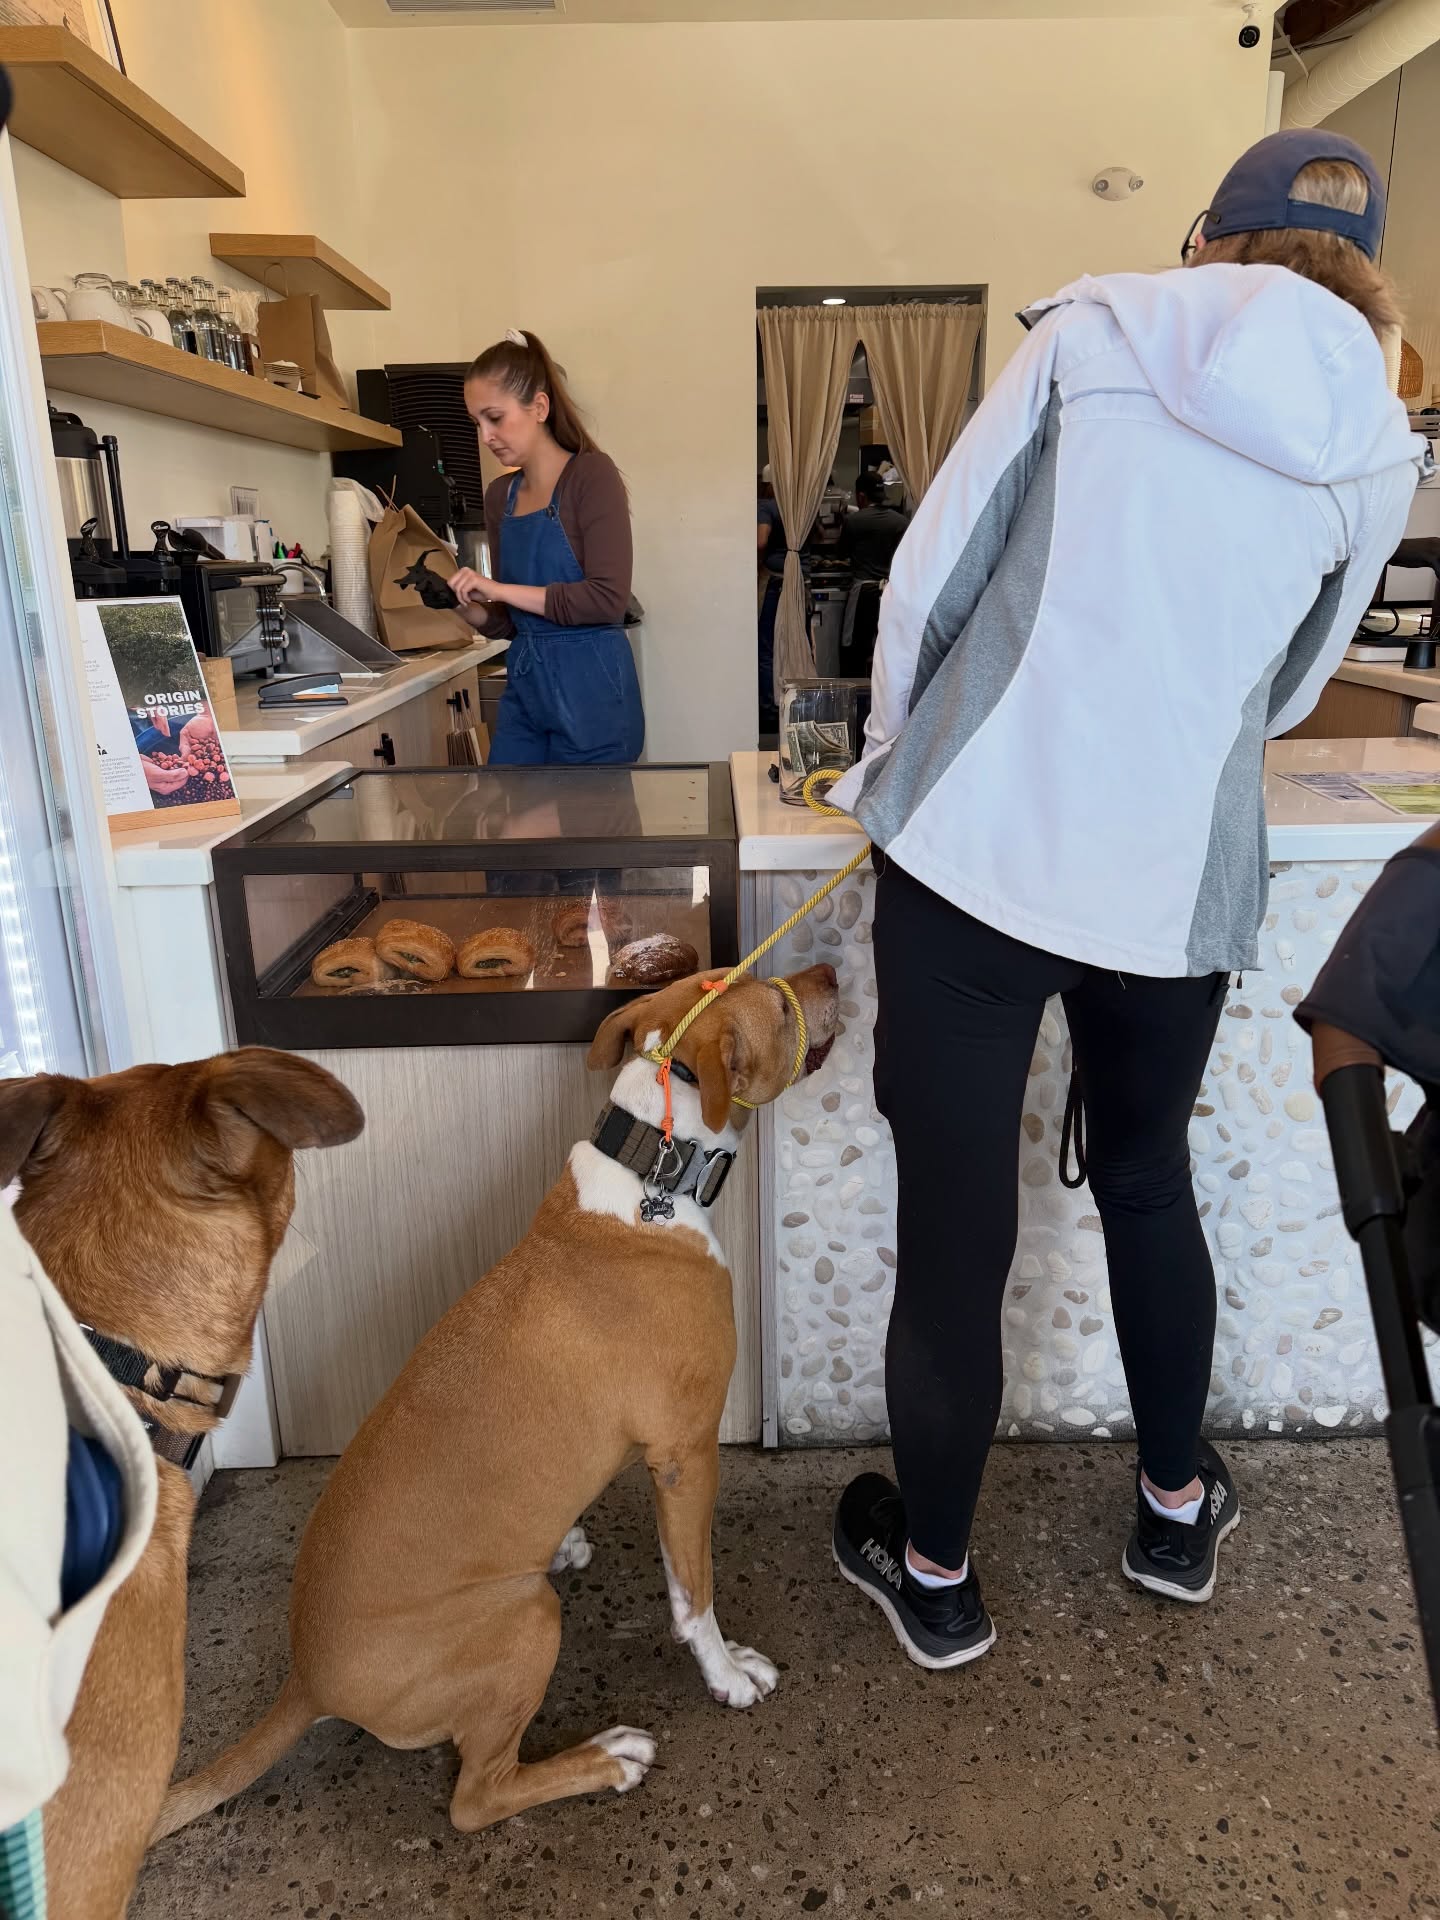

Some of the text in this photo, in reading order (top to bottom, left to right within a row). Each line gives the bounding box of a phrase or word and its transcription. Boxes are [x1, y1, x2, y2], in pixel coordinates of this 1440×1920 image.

[144, 690, 201, 705] ORIGIN
[136, 702, 205, 719] STORIES
[860, 1538, 902, 1591] HOKA
